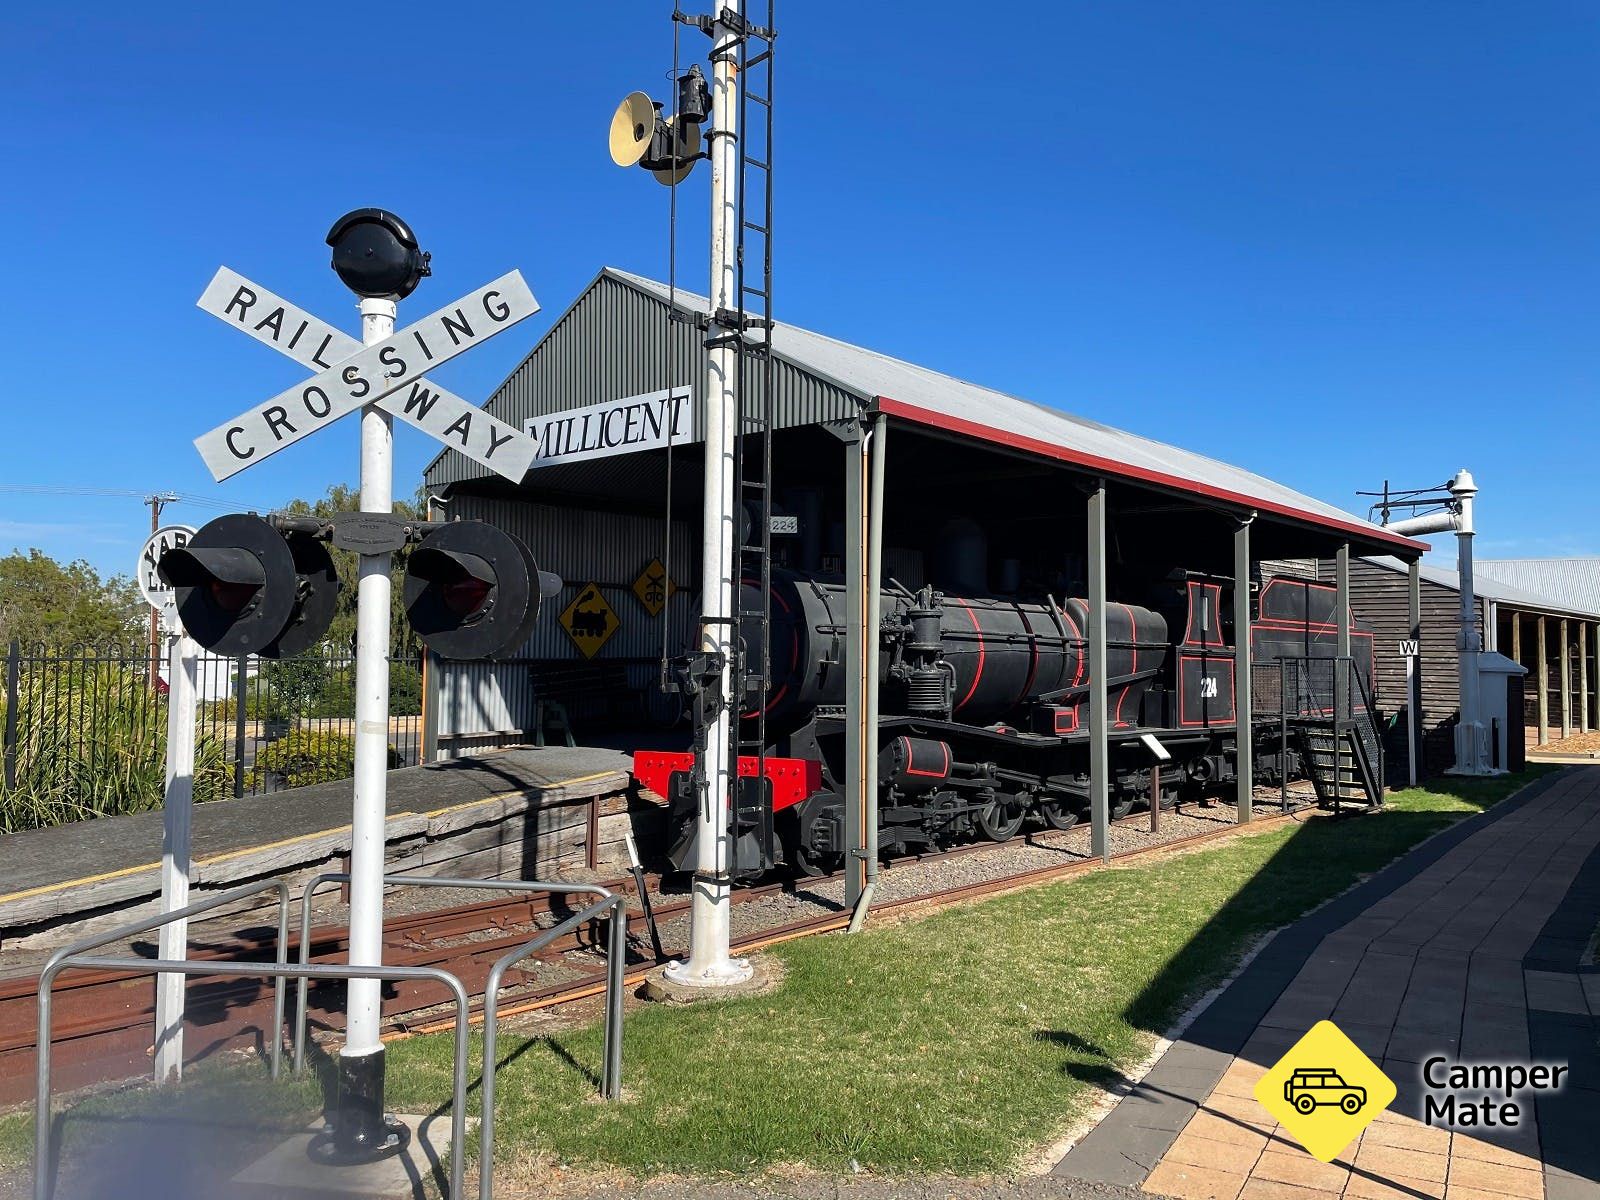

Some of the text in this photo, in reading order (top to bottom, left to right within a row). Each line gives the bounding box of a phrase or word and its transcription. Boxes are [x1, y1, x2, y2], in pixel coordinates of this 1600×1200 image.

[224, 285, 514, 460] RAIL WAY
[225, 290, 511, 460] CROSSING
[529, 394, 690, 460] MILLICENT
[772, 520, 794, 530] 224
[144, 532, 187, 570] YAR
[1401, 641, 1416, 654] W
[1200, 677, 1218, 698] 224
